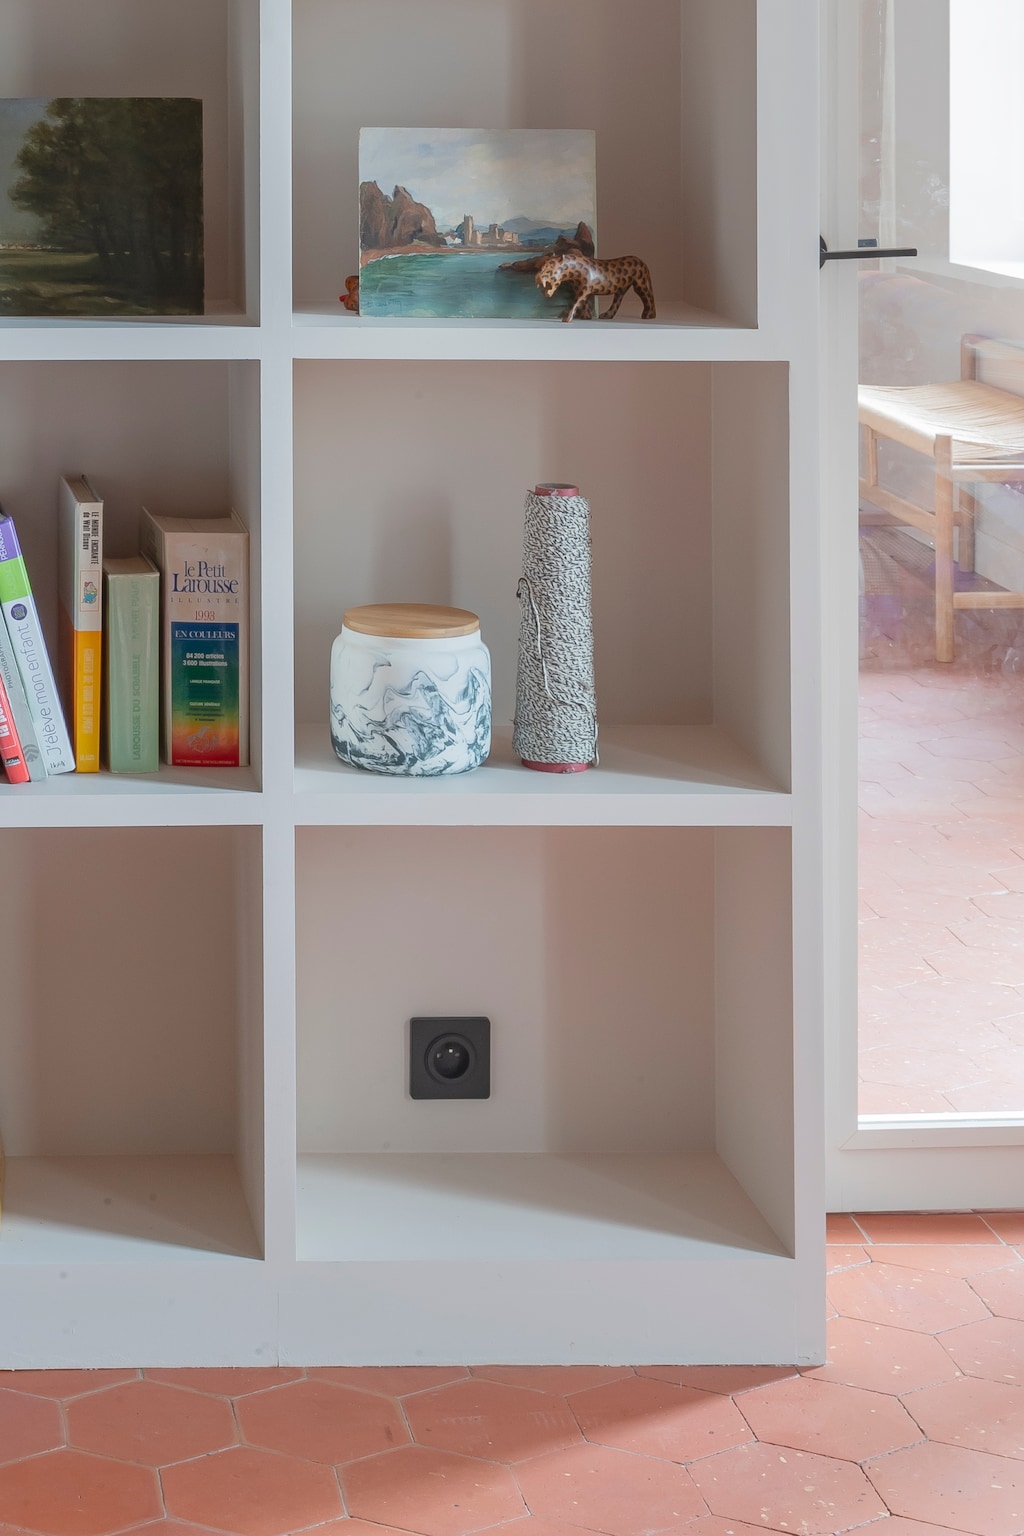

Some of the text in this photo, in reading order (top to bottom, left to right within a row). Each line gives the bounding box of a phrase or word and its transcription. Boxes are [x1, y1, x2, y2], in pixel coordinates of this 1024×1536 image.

[184, 560, 227, 578] le Petit
[171, 573, 239, 595] Larousse
[195, 610, 216, 622] 1993
[175, 629, 236, 640] EN COULEURS
[16, 622, 63, 756] J'élève mon enfant
[132, 654, 142, 761] LAROUSSE DU SCRABBLE
